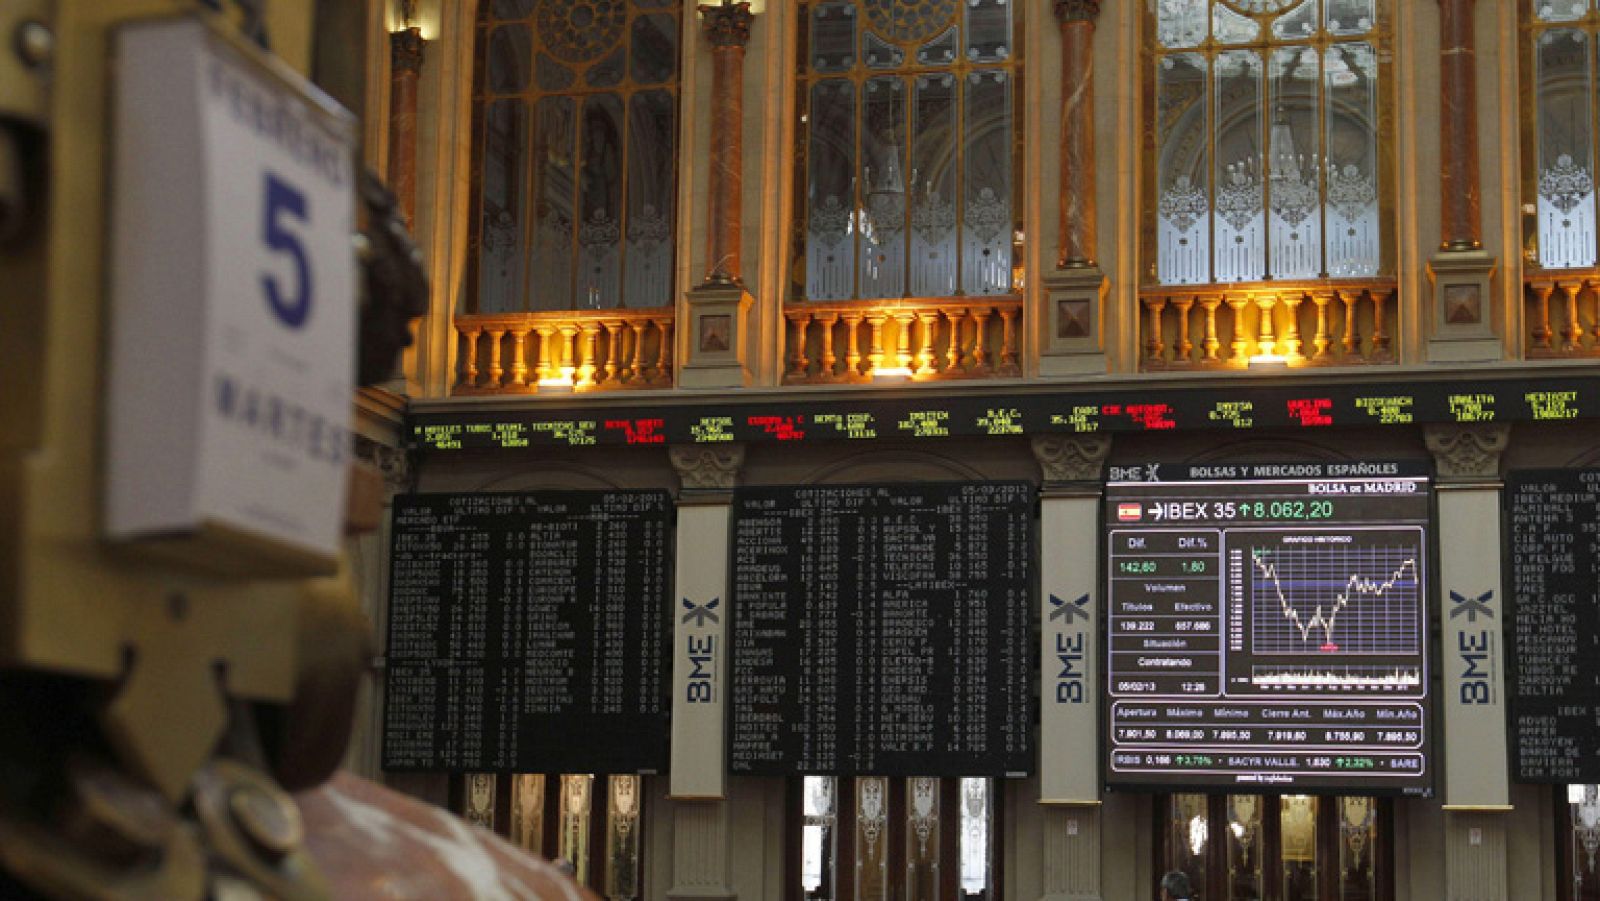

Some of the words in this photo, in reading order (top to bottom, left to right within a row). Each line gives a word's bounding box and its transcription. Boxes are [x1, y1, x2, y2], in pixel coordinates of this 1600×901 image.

[259, 170, 314, 330] 5
[1190, 466, 1236, 478] BOLSAS
[1241, 466, 1249, 477] Y
[1253, 464, 1322, 477] MERCADOS
[1327, 462, 1399, 475] ESPAÑOLES
[1308, 483, 1349, 494] BOLSA
[1364, 482, 1417, 493] MADRID
[1163, 502, 1209, 519] IBEX
[1214, 502, 1236, 519] 35
[1253, 500, 1333, 520] 8.062,20
[1144, 583, 1187, 592] Volumen
[687, 634, 712, 703] BME
[1056, 632, 1083, 703] BME
[1137, 656, 1192, 667] Contratando
[1458, 630, 1489, 705] BME
[1117, 706, 1157, 719] Apertura
[1261, 708, 1289, 719] Cierre
